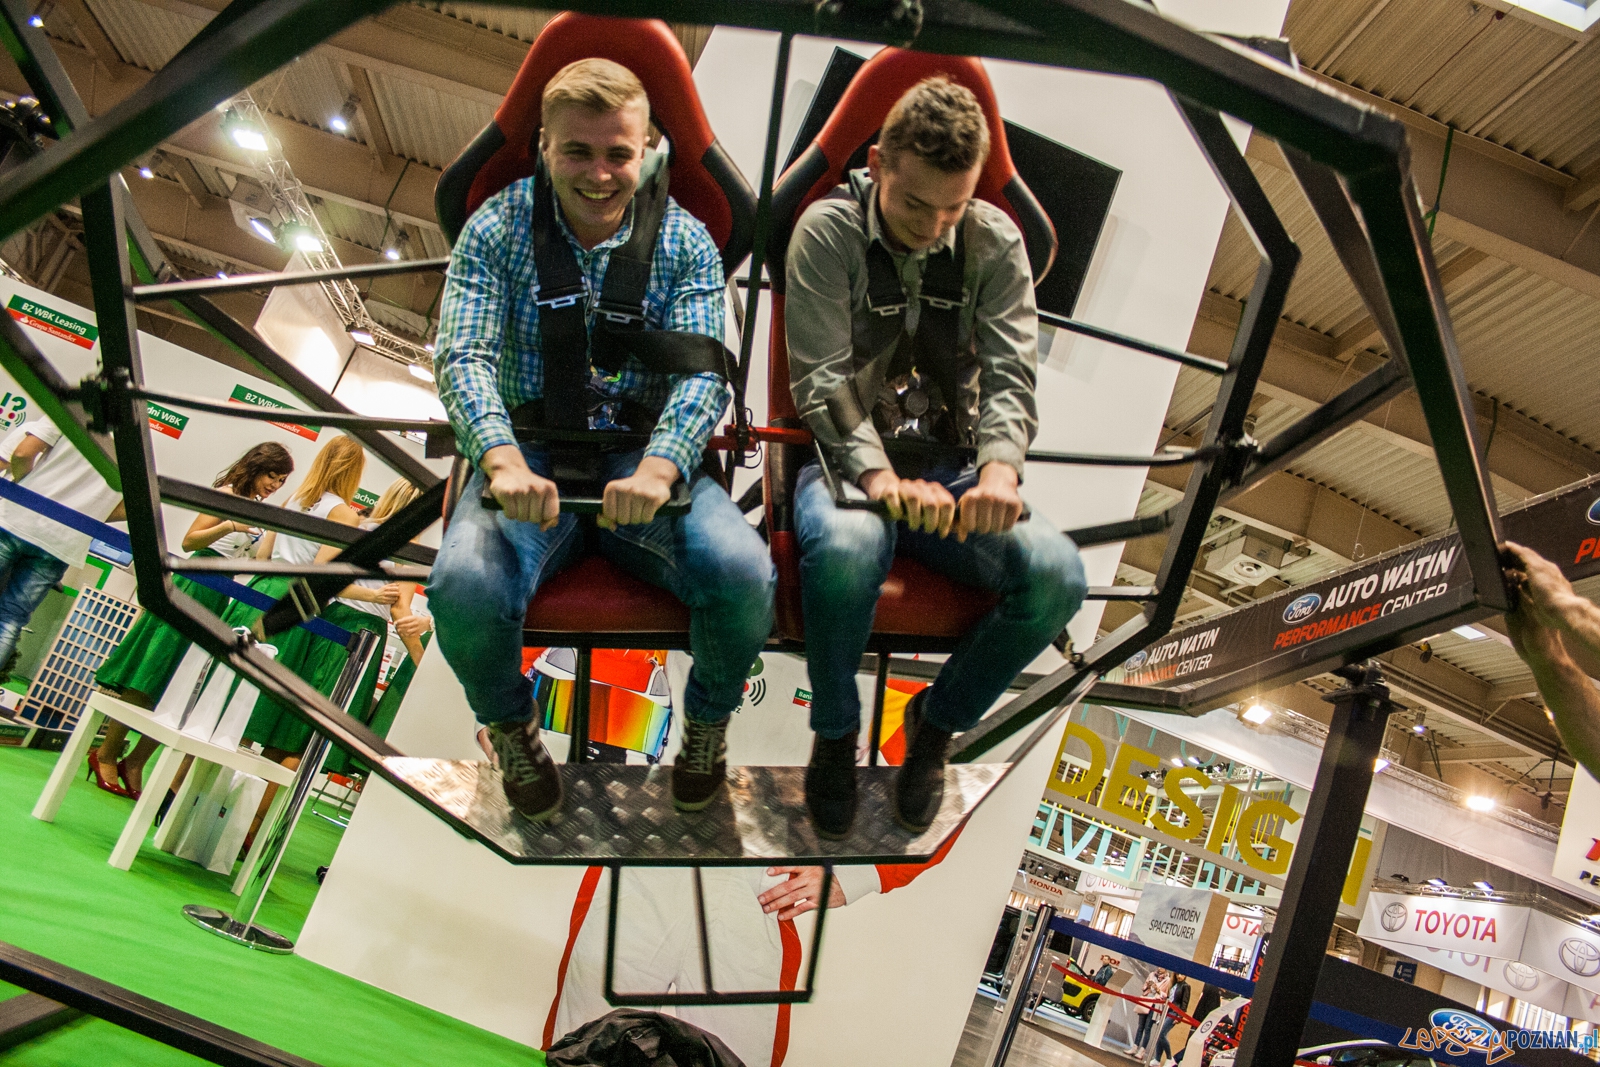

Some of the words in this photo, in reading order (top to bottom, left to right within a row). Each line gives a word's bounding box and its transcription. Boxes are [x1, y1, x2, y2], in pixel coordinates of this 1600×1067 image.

[21, 302, 35, 312] BZ
[35, 307, 55, 321] WBK
[54, 316, 87, 335] Leasing
[29, 319, 48, 331] Grupa
[48, 326, 77, 342] Santander
[245, 393, 257, 403] BZ
[161, 412, 182, 426] WBK
[1321, 574, 1379, 613] AUTO
[1380, 547, 1456, 594] WATIN
[1273, 602, 1383, 650] PERFORMANCE
[1146, 641, 1180, 666] AUTO
[1178, 626, 1221, 657] WATIN
[1176, 653, 1213, 677] CENTER
[1028, 877, 1064, 896] HONDA
[1169, 906, 1201, 924] CITROËN
[1414, 908, 1498, 943] TOYOTA
[1149, 918, 1196, 940] SPACETOURER
